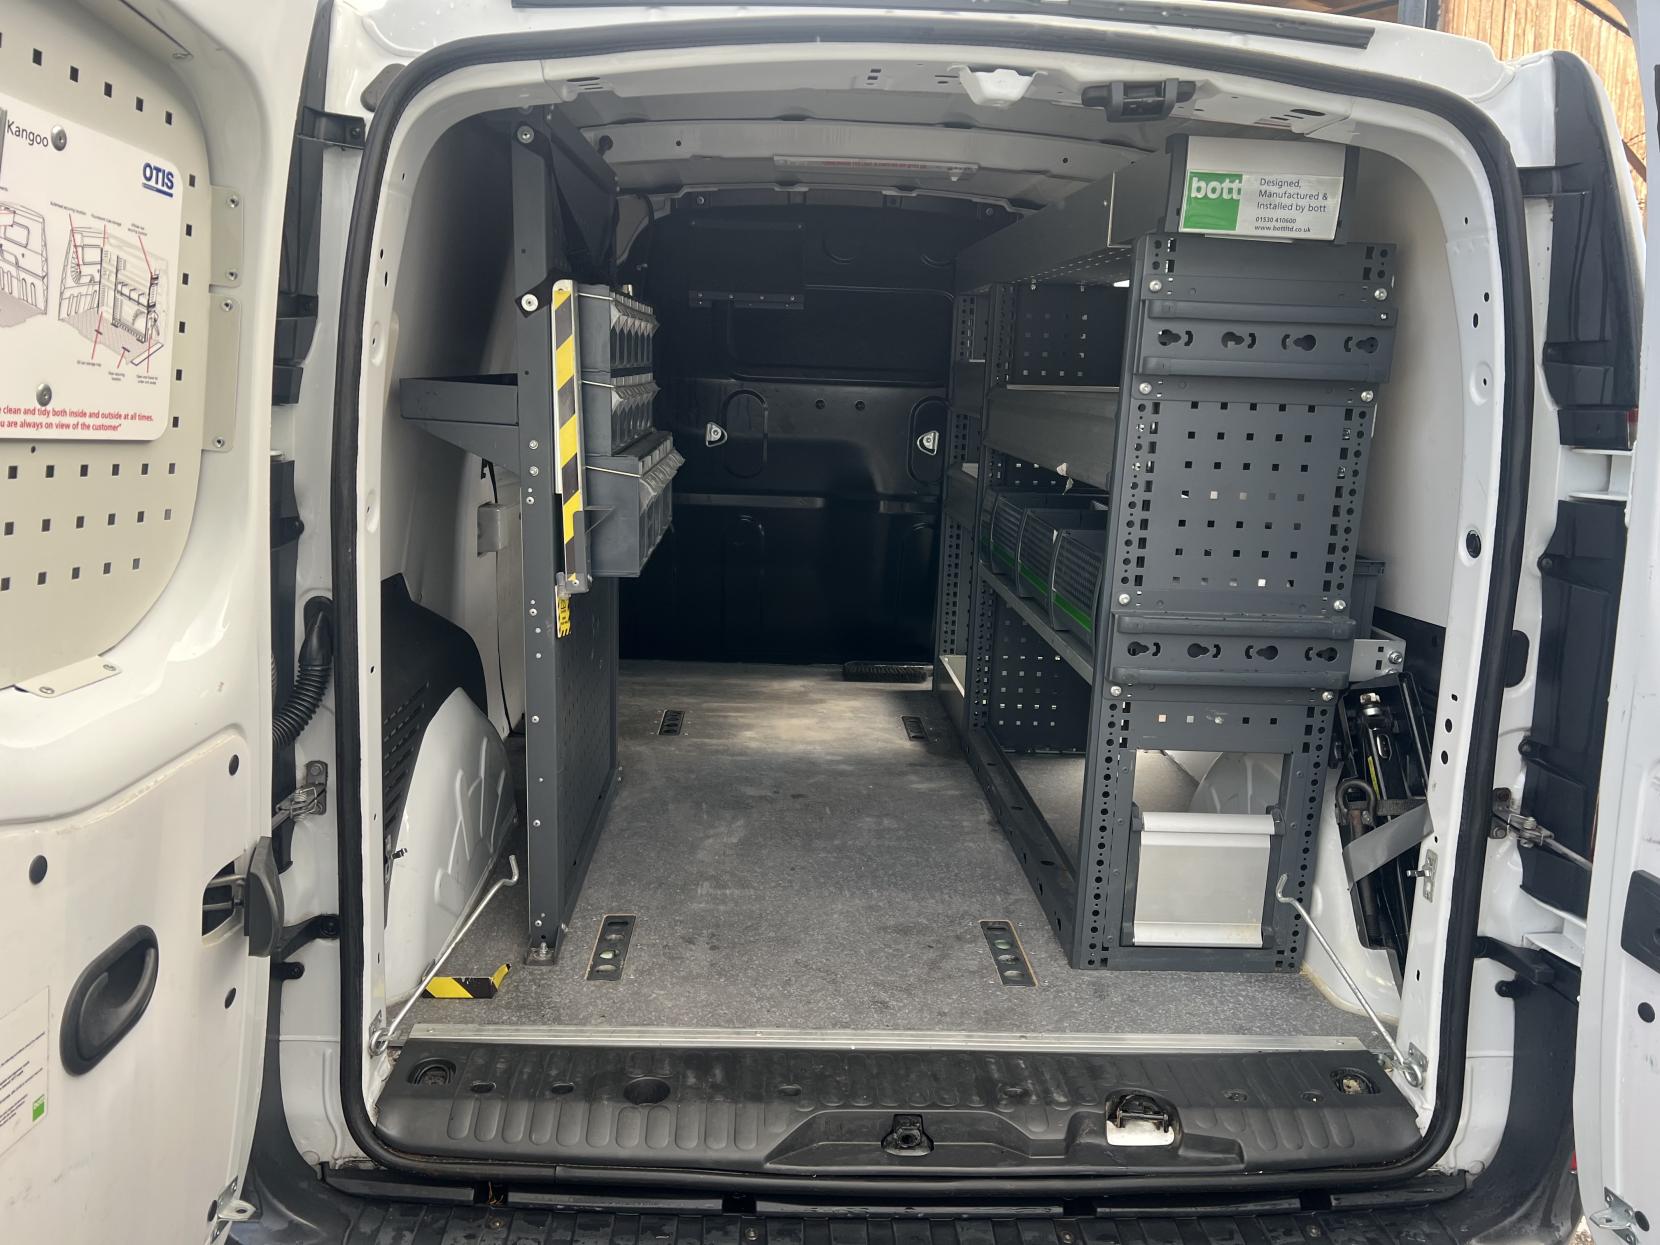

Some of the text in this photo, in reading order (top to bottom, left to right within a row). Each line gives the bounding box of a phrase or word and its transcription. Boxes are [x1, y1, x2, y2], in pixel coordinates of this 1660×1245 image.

[7, 119, 49, 148] Kangoo
[142, 162, 175, 191] OTIS
[1259, 177, 1302, 189] Designed,
[1191, 176, 1242, 200] bott
[1258, 189, 1329, 201] Manufactured &
[1257, 202, 1327, 213] Installed by bott
[3, 405, 22, 415] clean
[23, 406, 36, 416] and
[37, 406, 51, 418] tidy
[52, 407, 68, 417] both
[68, 408, 87, 418] inside
[88, 410, 100, 419] and
[100, 410, 122, 420] outside
[123, 412, 129, 420] at
[6, 420, 18, 428] are
[19, 418, 44, 431] always
[44, 422, 54, 430] on
[54, 421, 71, 430] view
[72, 421, 80, 430] of
[80, 421, 91, 431] the
